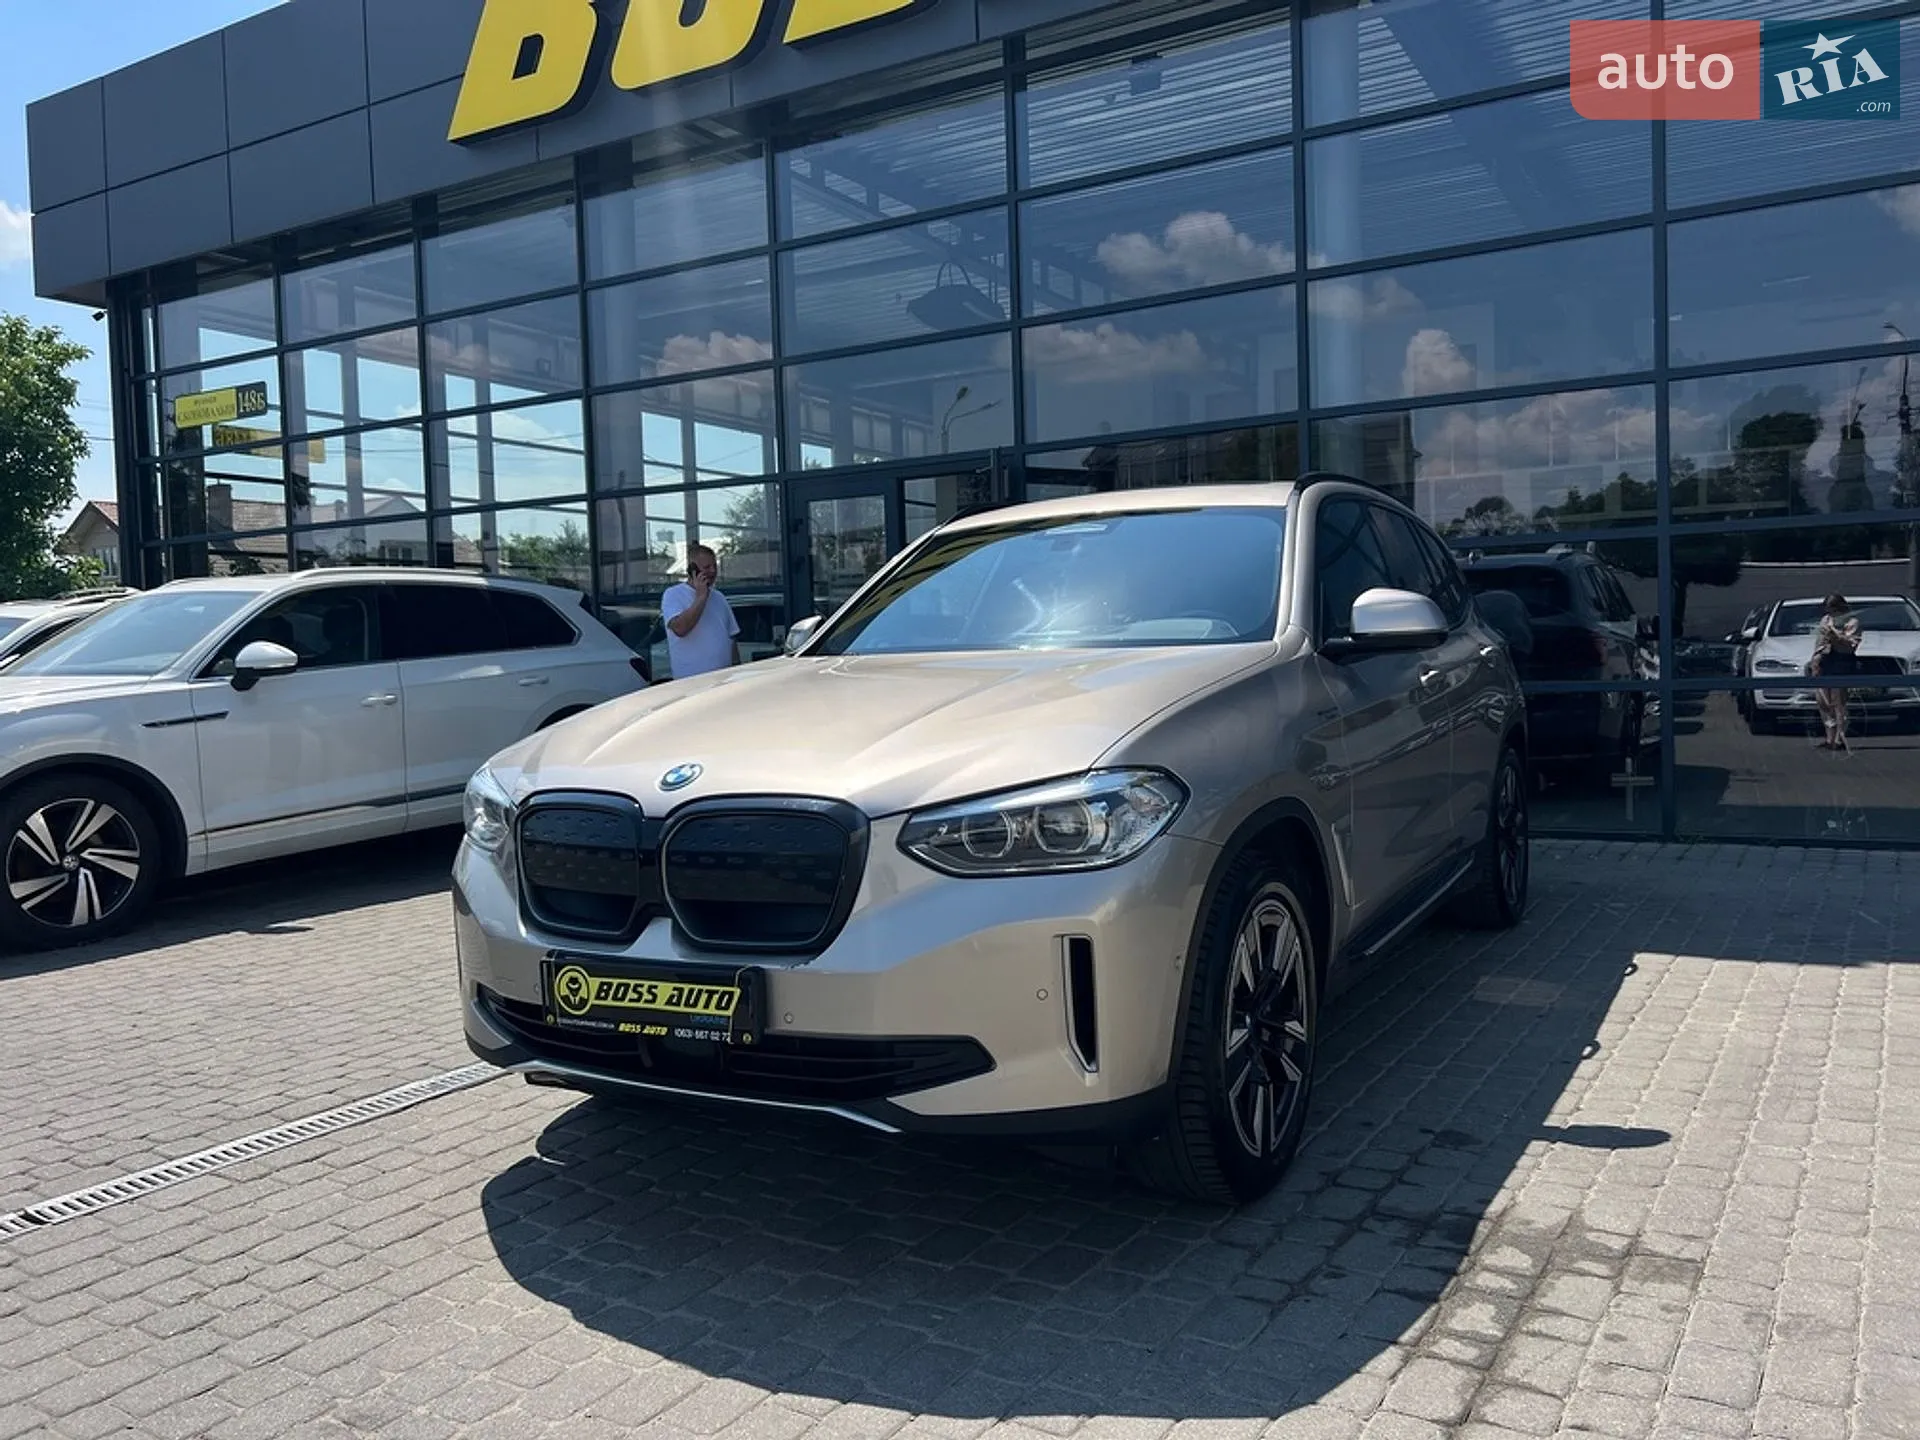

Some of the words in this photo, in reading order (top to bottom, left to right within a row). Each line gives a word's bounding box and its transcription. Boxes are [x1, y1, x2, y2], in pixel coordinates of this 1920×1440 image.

[594, 981, 658, 1003] BOSS
[664, 986, 735, 1011] AUTO
[618, 1023, 641, 1034] BOSS
[642, 1025, 668, 1036] AUTO
